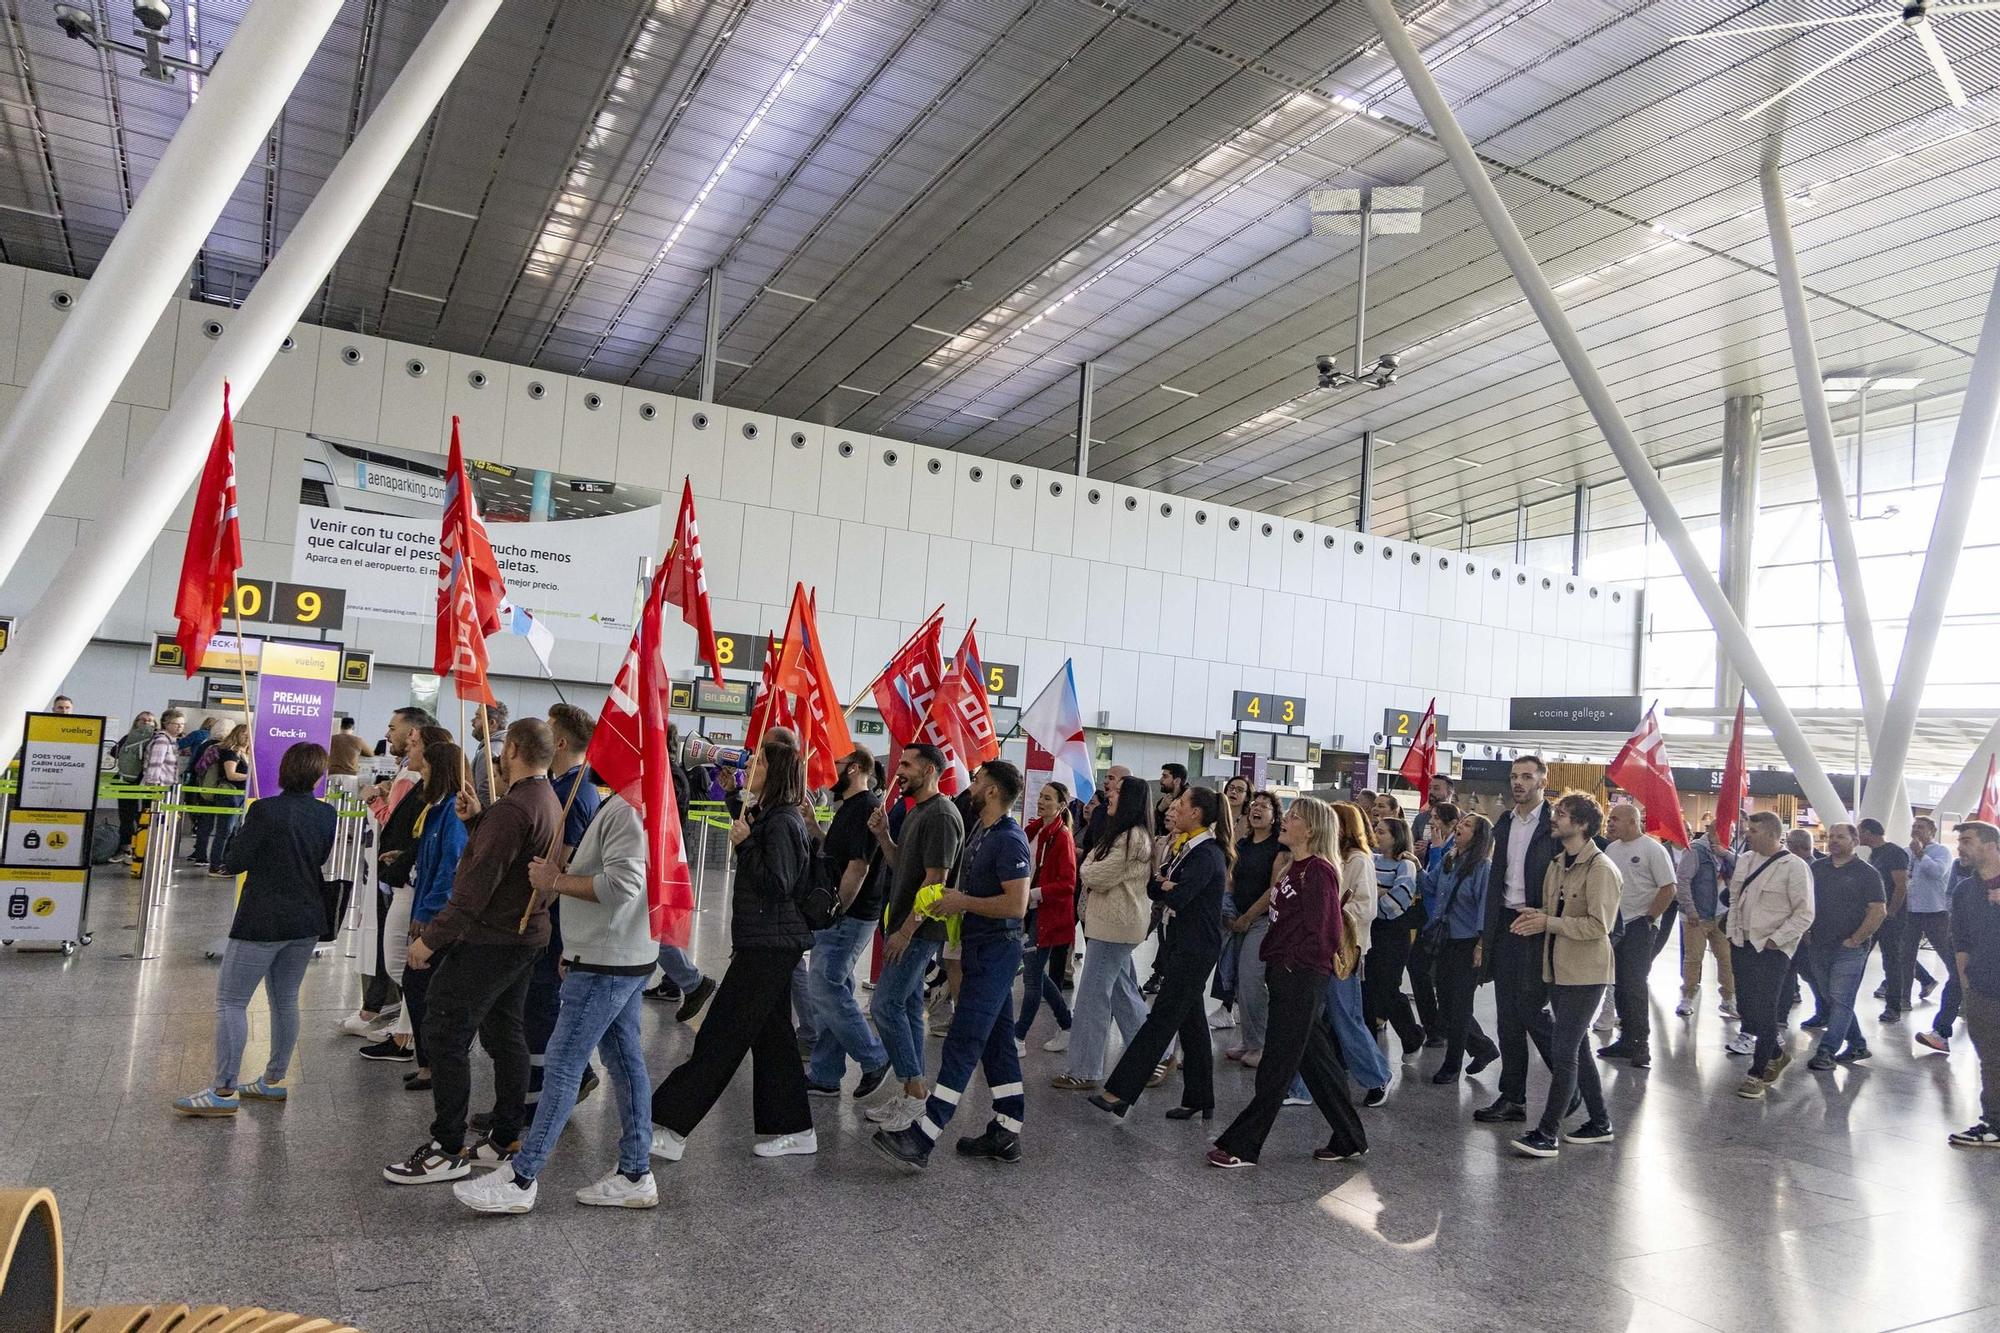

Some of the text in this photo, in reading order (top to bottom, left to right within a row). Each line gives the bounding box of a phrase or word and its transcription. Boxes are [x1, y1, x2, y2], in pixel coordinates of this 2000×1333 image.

[368, 471, 446, 499] aenaparking.com
[310, 517, 436, 545] Venir con tu coche
[307, 535, 335, 548] que
[338, 538, 392, 555] calcular
[394, 546, 407, 557] el
[305, 552, 339, 566] Aparca
[340, 557, 352, 566] en
[354, 558, 363, 567] el
[366, 560, 418, 576] aeropuerto.
[419, 566, 429, 575] El
[530, 551, 572, 564] menos
[507, 578, 532, 590] mejor
[532, 581, 560, 592] precio.
[221, 584, 262, 616] 0
[296, 591, 322, 622] 9
[716, 637, 734, 664] 8
[295, 657, 326, 669] vueling
[988, 667, 1004, 692] 5
[273, 691, 322, 705] PREMIUM
[704, 693, 741, 704] BILBAO
[271, 703, 320, 717] TIMEFLEX
[1247, 696, 1295, 722] 4 3
[1539, 707, 1605, 721] cocina gallega
[61, 727, 93, 737] vueling
[269, 727, 307, 738] Check-in
[1397, 713, 1409, 734] 2
